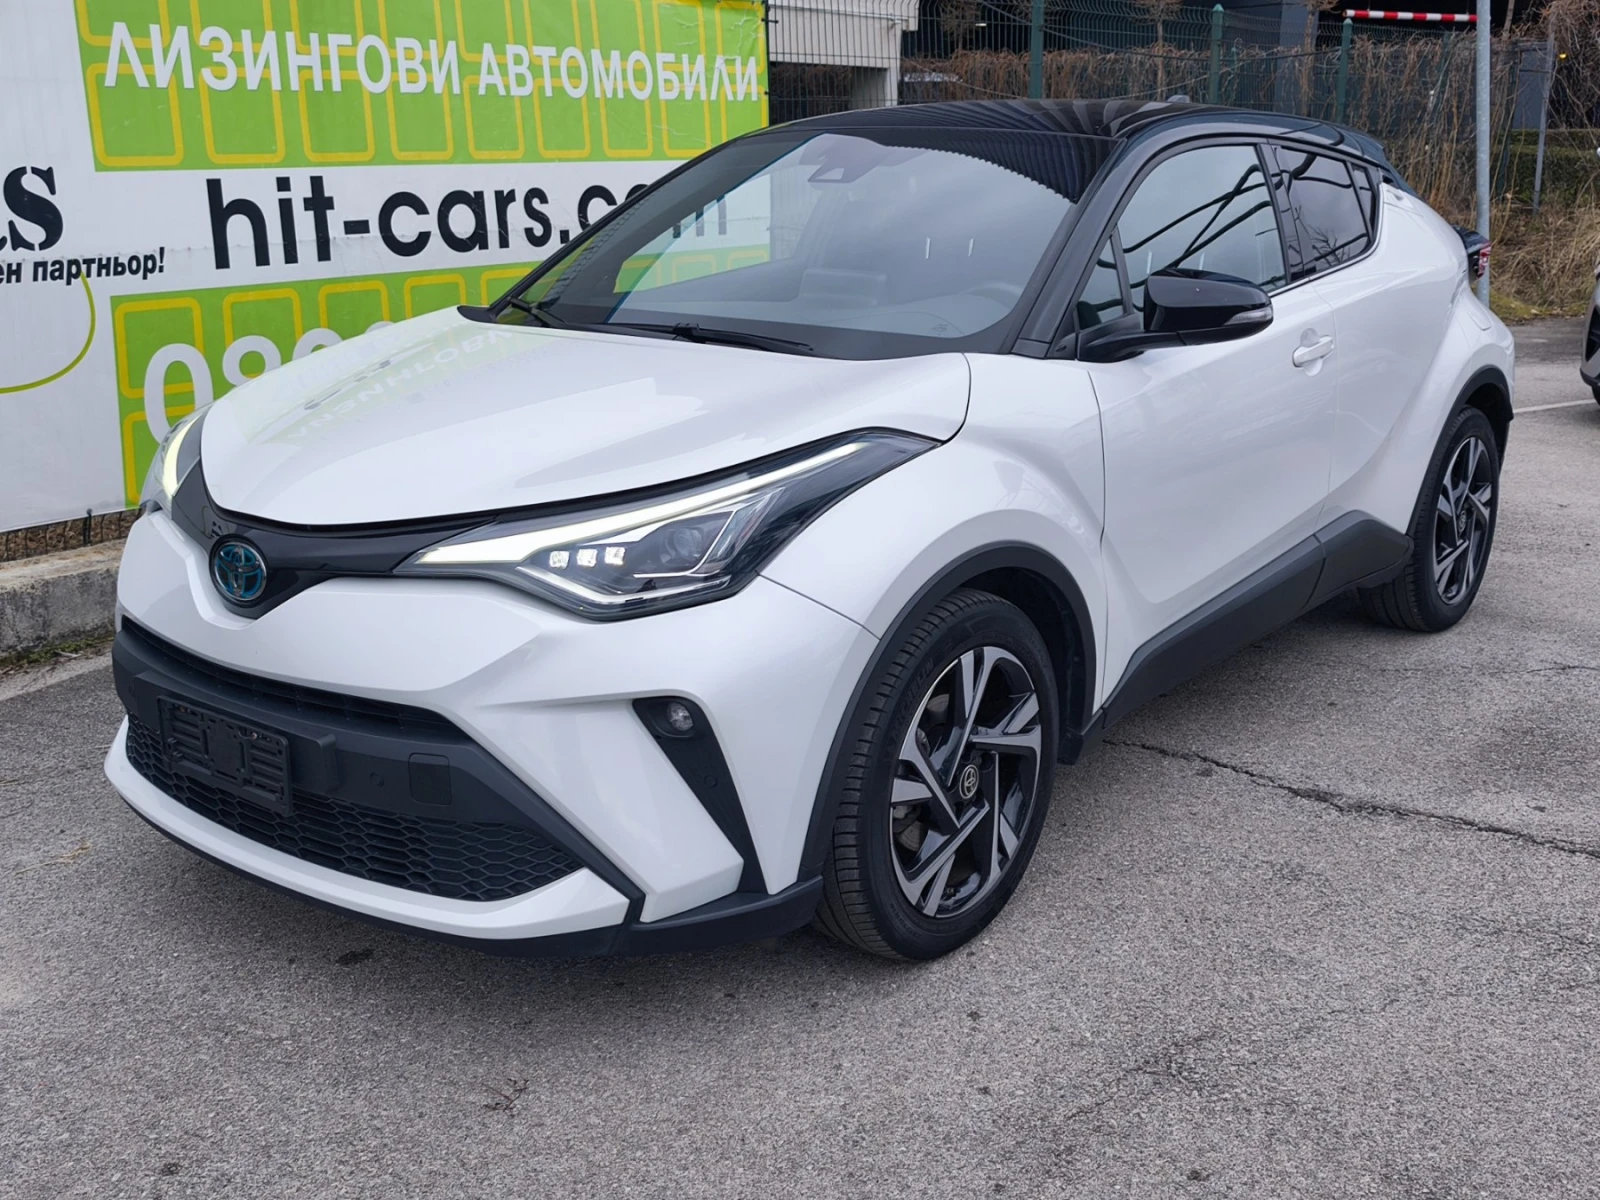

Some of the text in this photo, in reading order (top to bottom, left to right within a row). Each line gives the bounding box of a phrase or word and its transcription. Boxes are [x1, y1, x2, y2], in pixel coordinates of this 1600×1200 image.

[104, 21, 758, 101] ЛИЗИНГОВИ АВТОМОБИЛИ
[32, 246, 165, 286] партньор!
